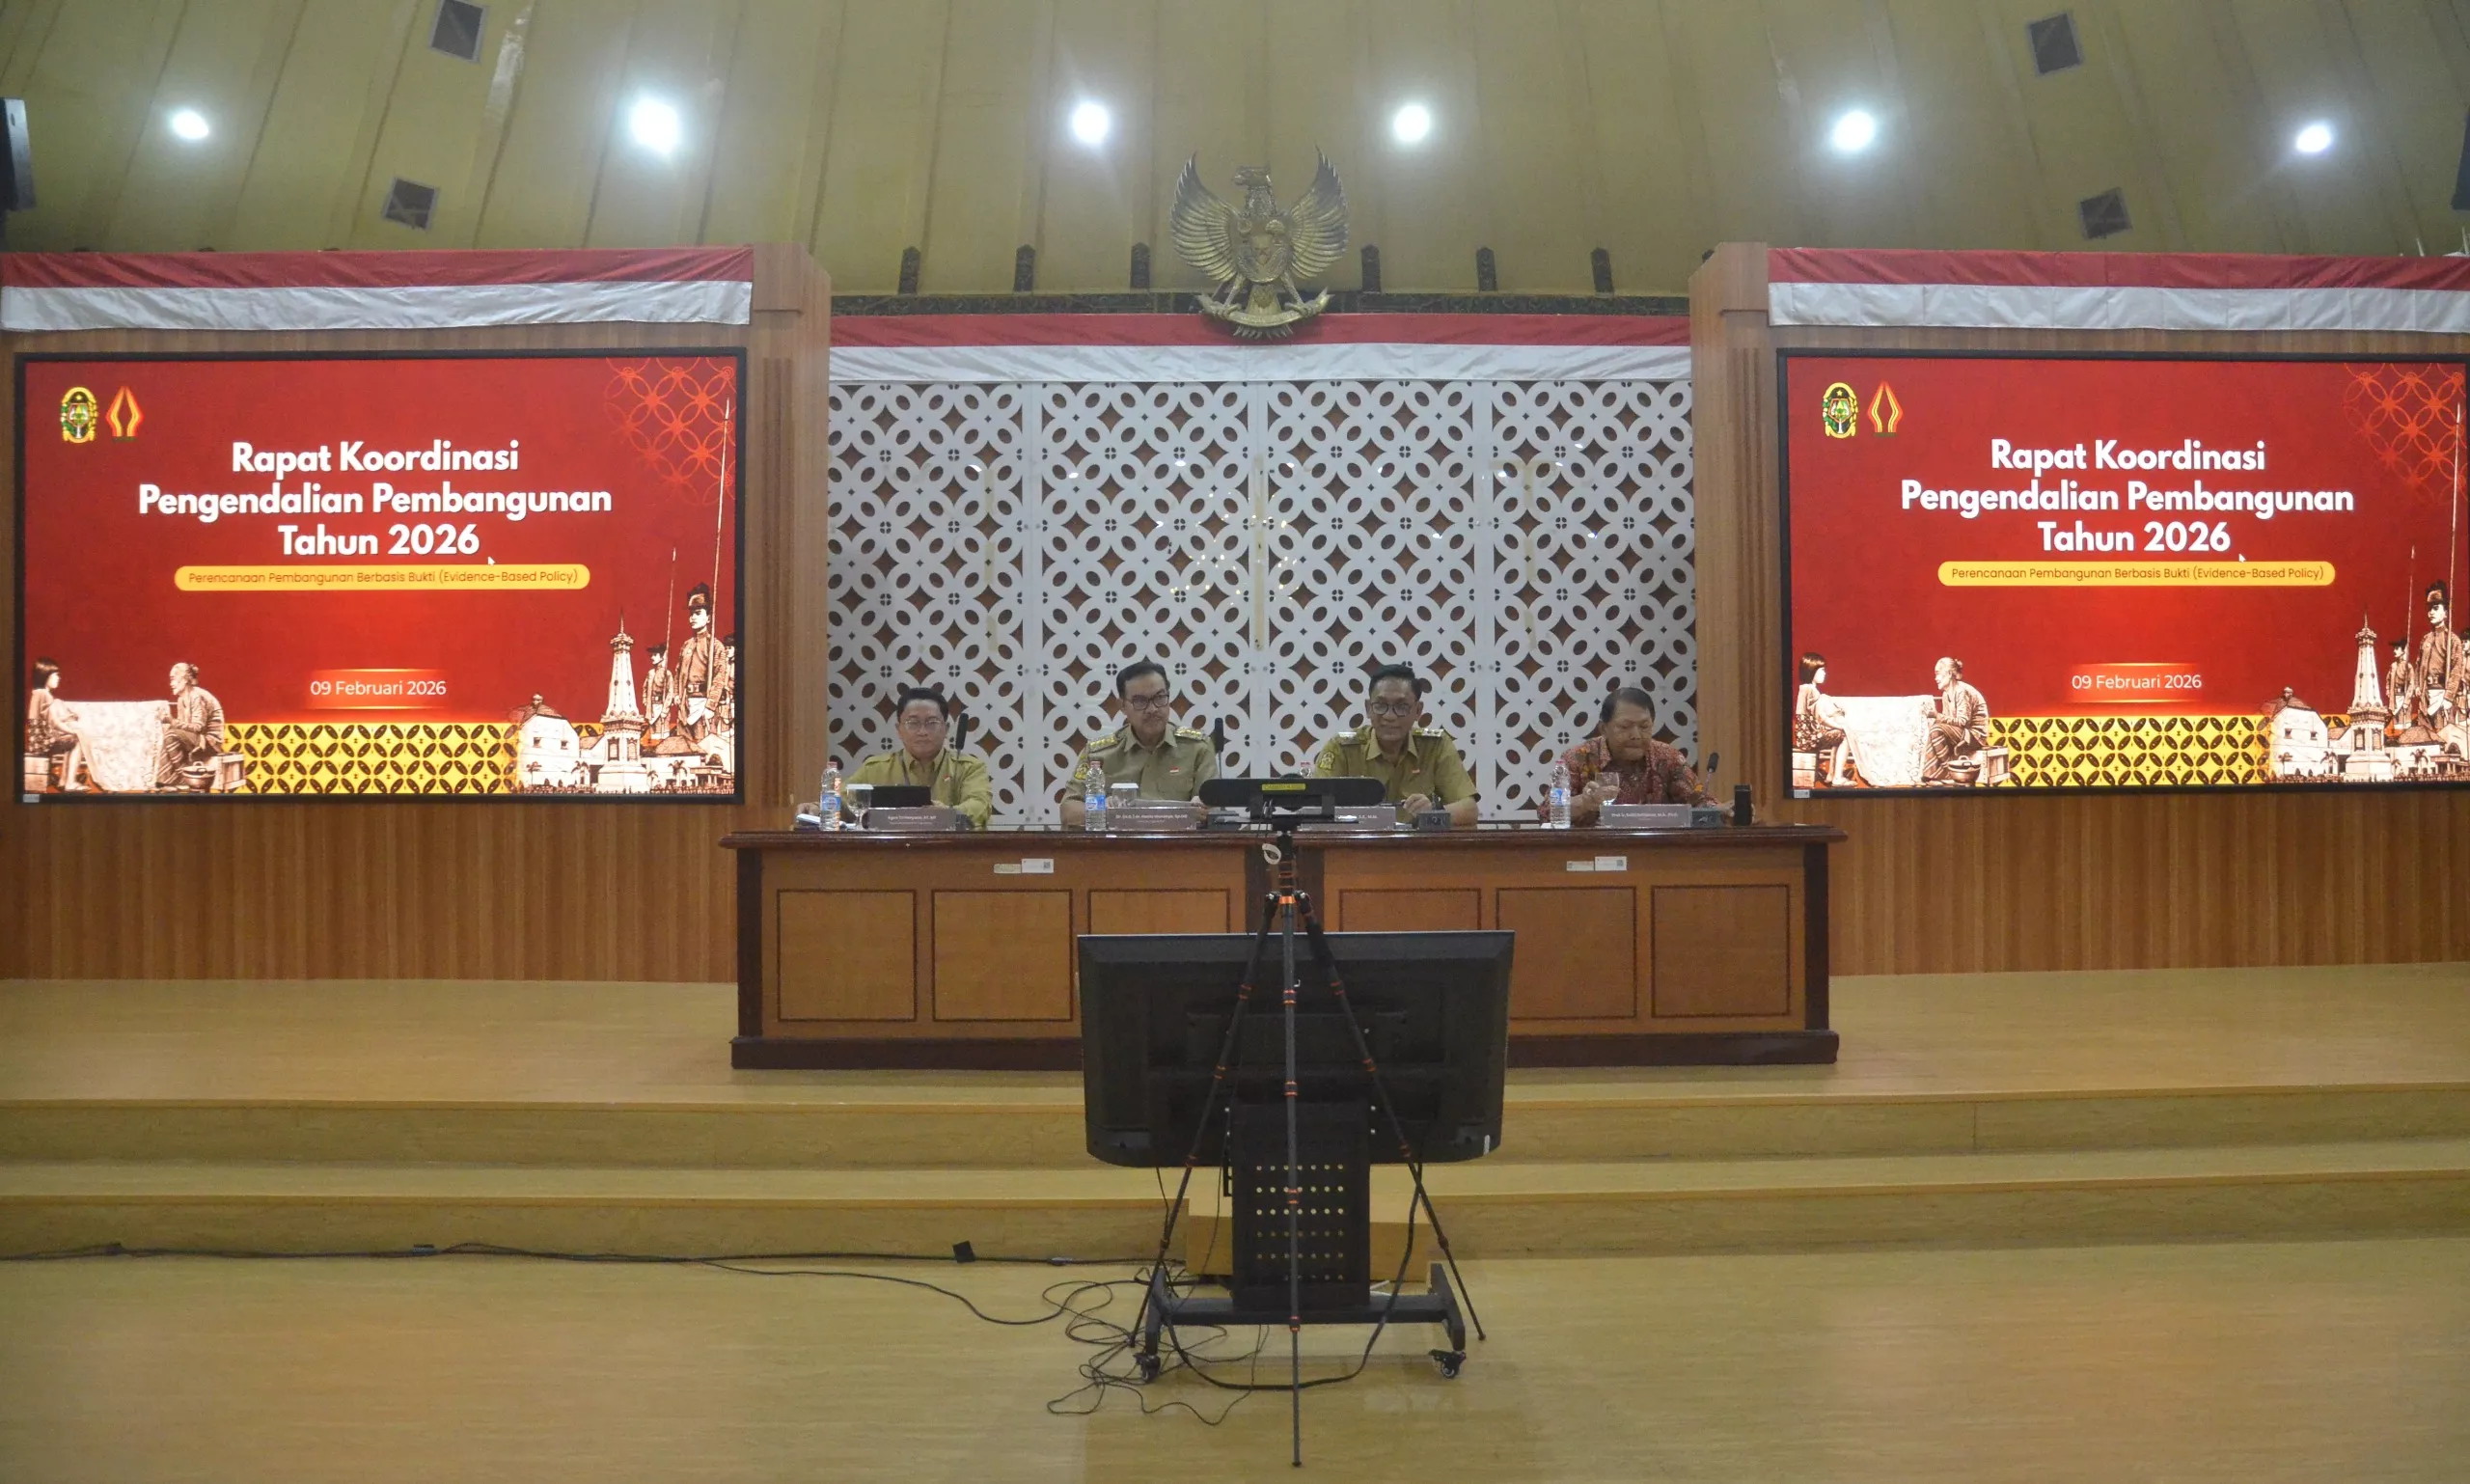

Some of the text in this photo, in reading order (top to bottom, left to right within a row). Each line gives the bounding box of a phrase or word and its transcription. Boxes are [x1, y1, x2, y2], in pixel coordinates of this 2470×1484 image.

[233, 440, 519, 481] Rapat Koordinasi
[1991, 438, 2265, 478] Rapat Koordinasi
[139, 481, 612, 522] Pengendalian Pembangunan
[1901, 480, 2354, 519] Pengendalian Pembangunan
[278, 524, 480, 556] Tahun 2026
[2038, 520, 2231, 552] Tahun 2026
[189, 569, 578, 586] Perencanaan Pembangunan Berbasis Bukti (Evidence-Based Policy)
[1952, 566, 2323, 581] Perencanaan Pembangunan Berbasis Bukti (Evidence-Based Policy)
[310, 680, 447, 696] 09 Februari 2026
[2072, 674, 2202, 690] 09 Februari 2026
